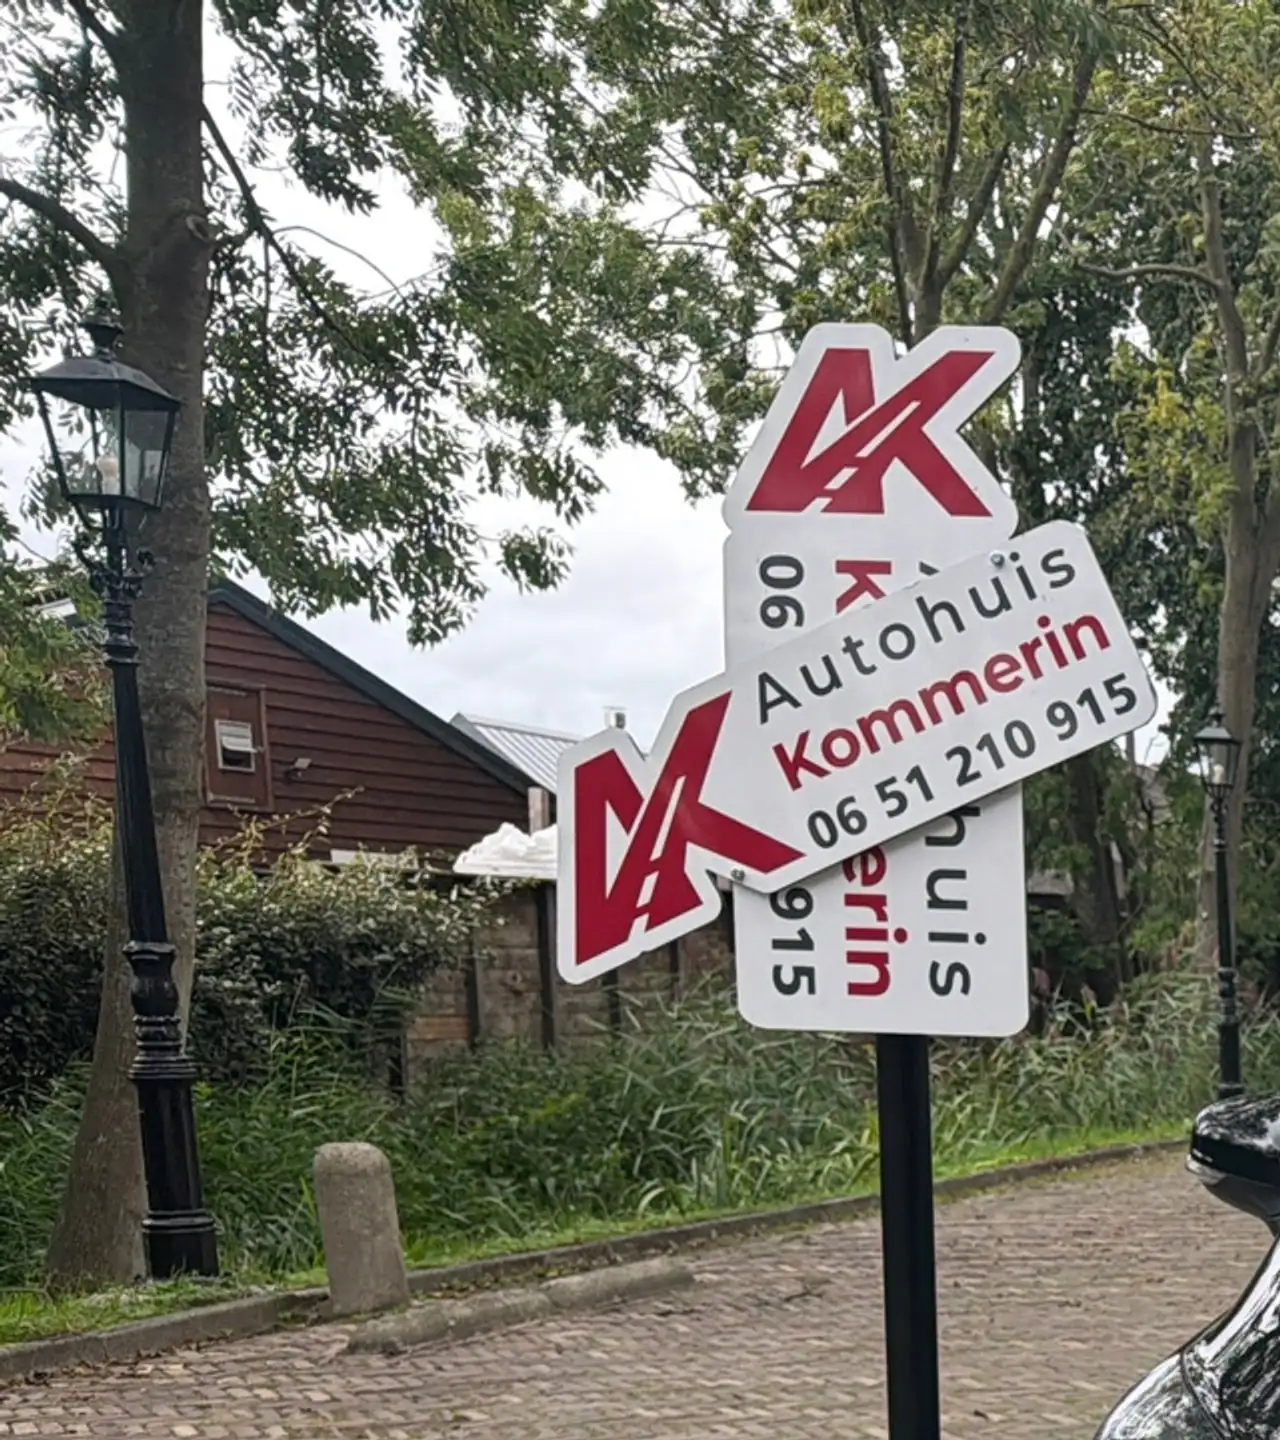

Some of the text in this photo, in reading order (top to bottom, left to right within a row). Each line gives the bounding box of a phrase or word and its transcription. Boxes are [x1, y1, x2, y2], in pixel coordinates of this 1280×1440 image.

[757, 548, 1076, 723] Autohuis
[773, 614, 1110, 792] Kommerin
[807, 673, 1138, 849] 06 51 210 915
